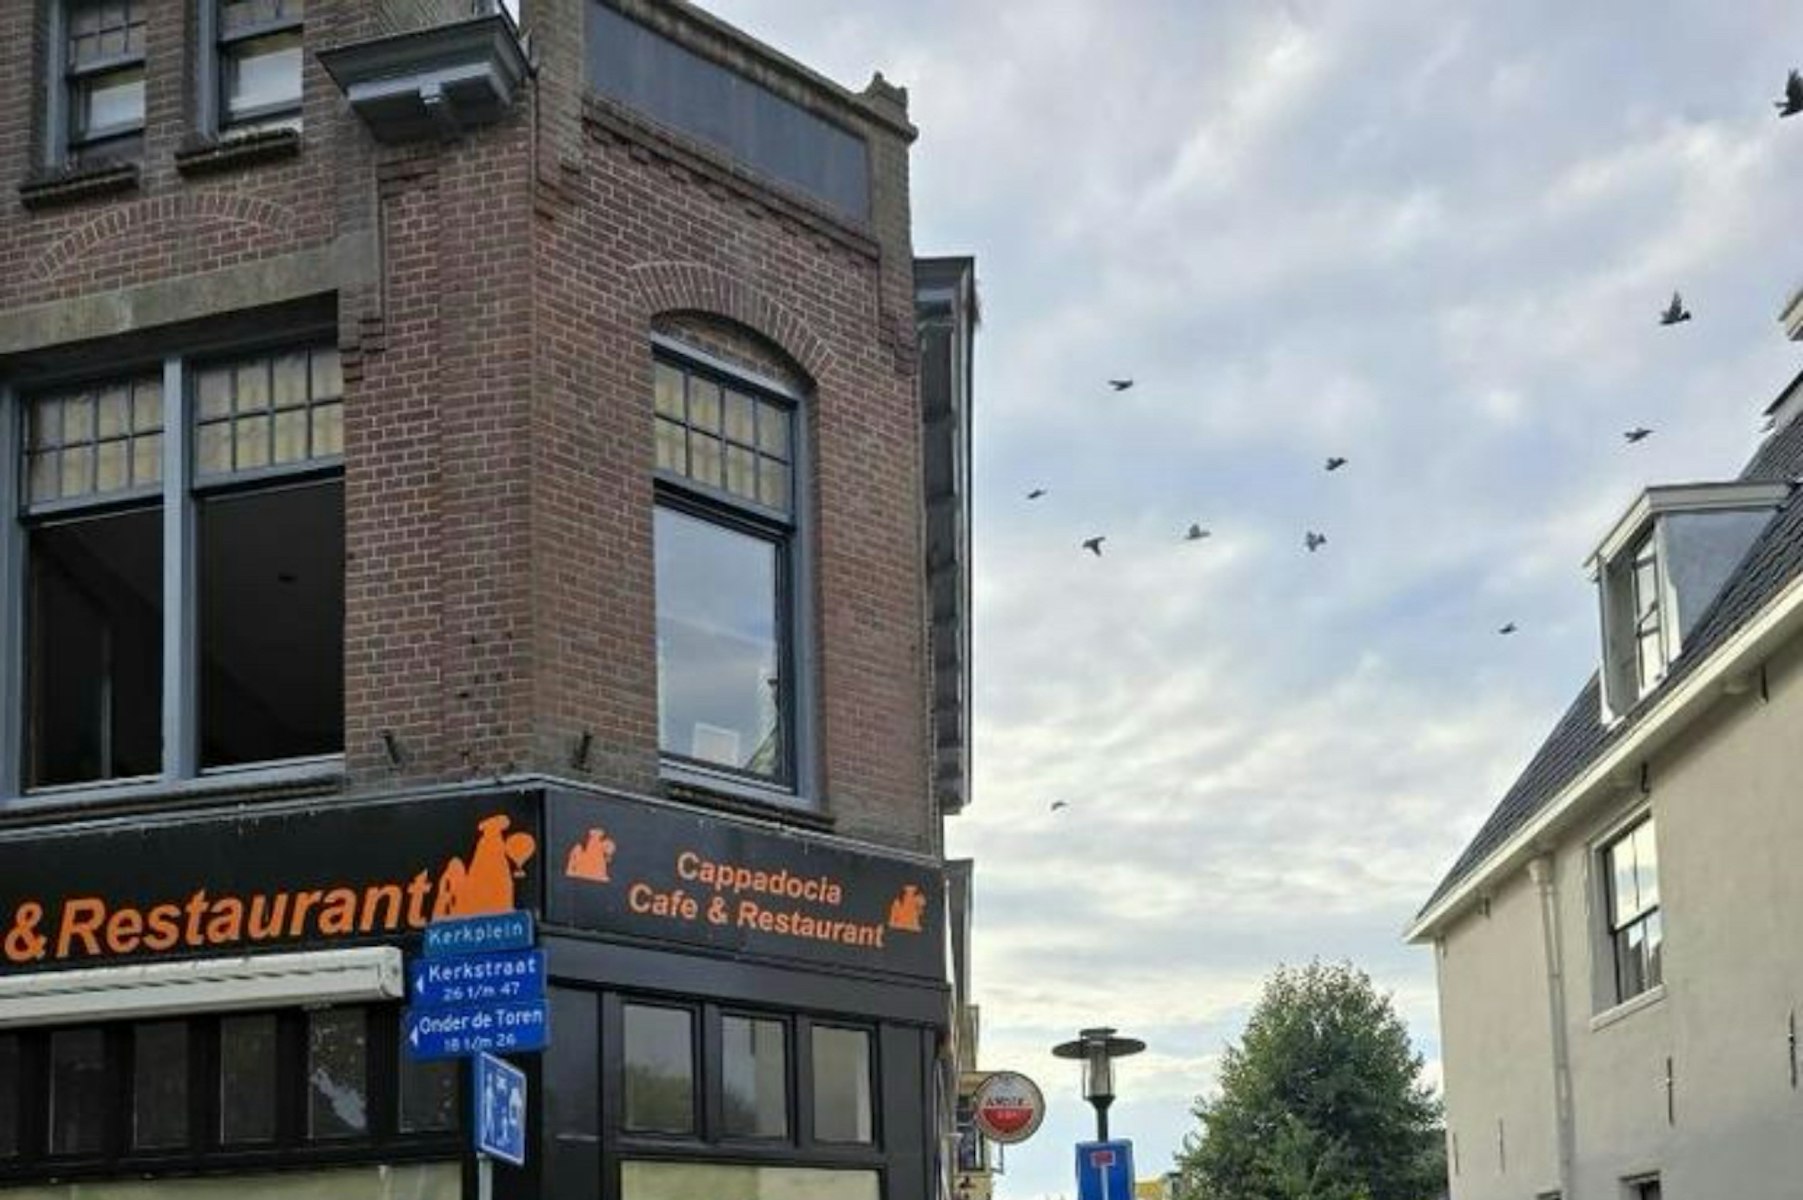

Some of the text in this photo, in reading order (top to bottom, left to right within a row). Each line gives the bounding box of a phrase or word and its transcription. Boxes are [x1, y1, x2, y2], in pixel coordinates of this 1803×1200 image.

[676, 851, 842, 906] Cappadocia
[4, 868, 433, 962] & Restaurant
[628, 883, 884, 949] Cafe & Restaurant
[428, 921, 523, 946] Kerkplein
[428, 958, 537, 983] Kerkstraat
[500, 981, 521, 996] 47
[419, 1008, 543, 1035] Onder de Toren
